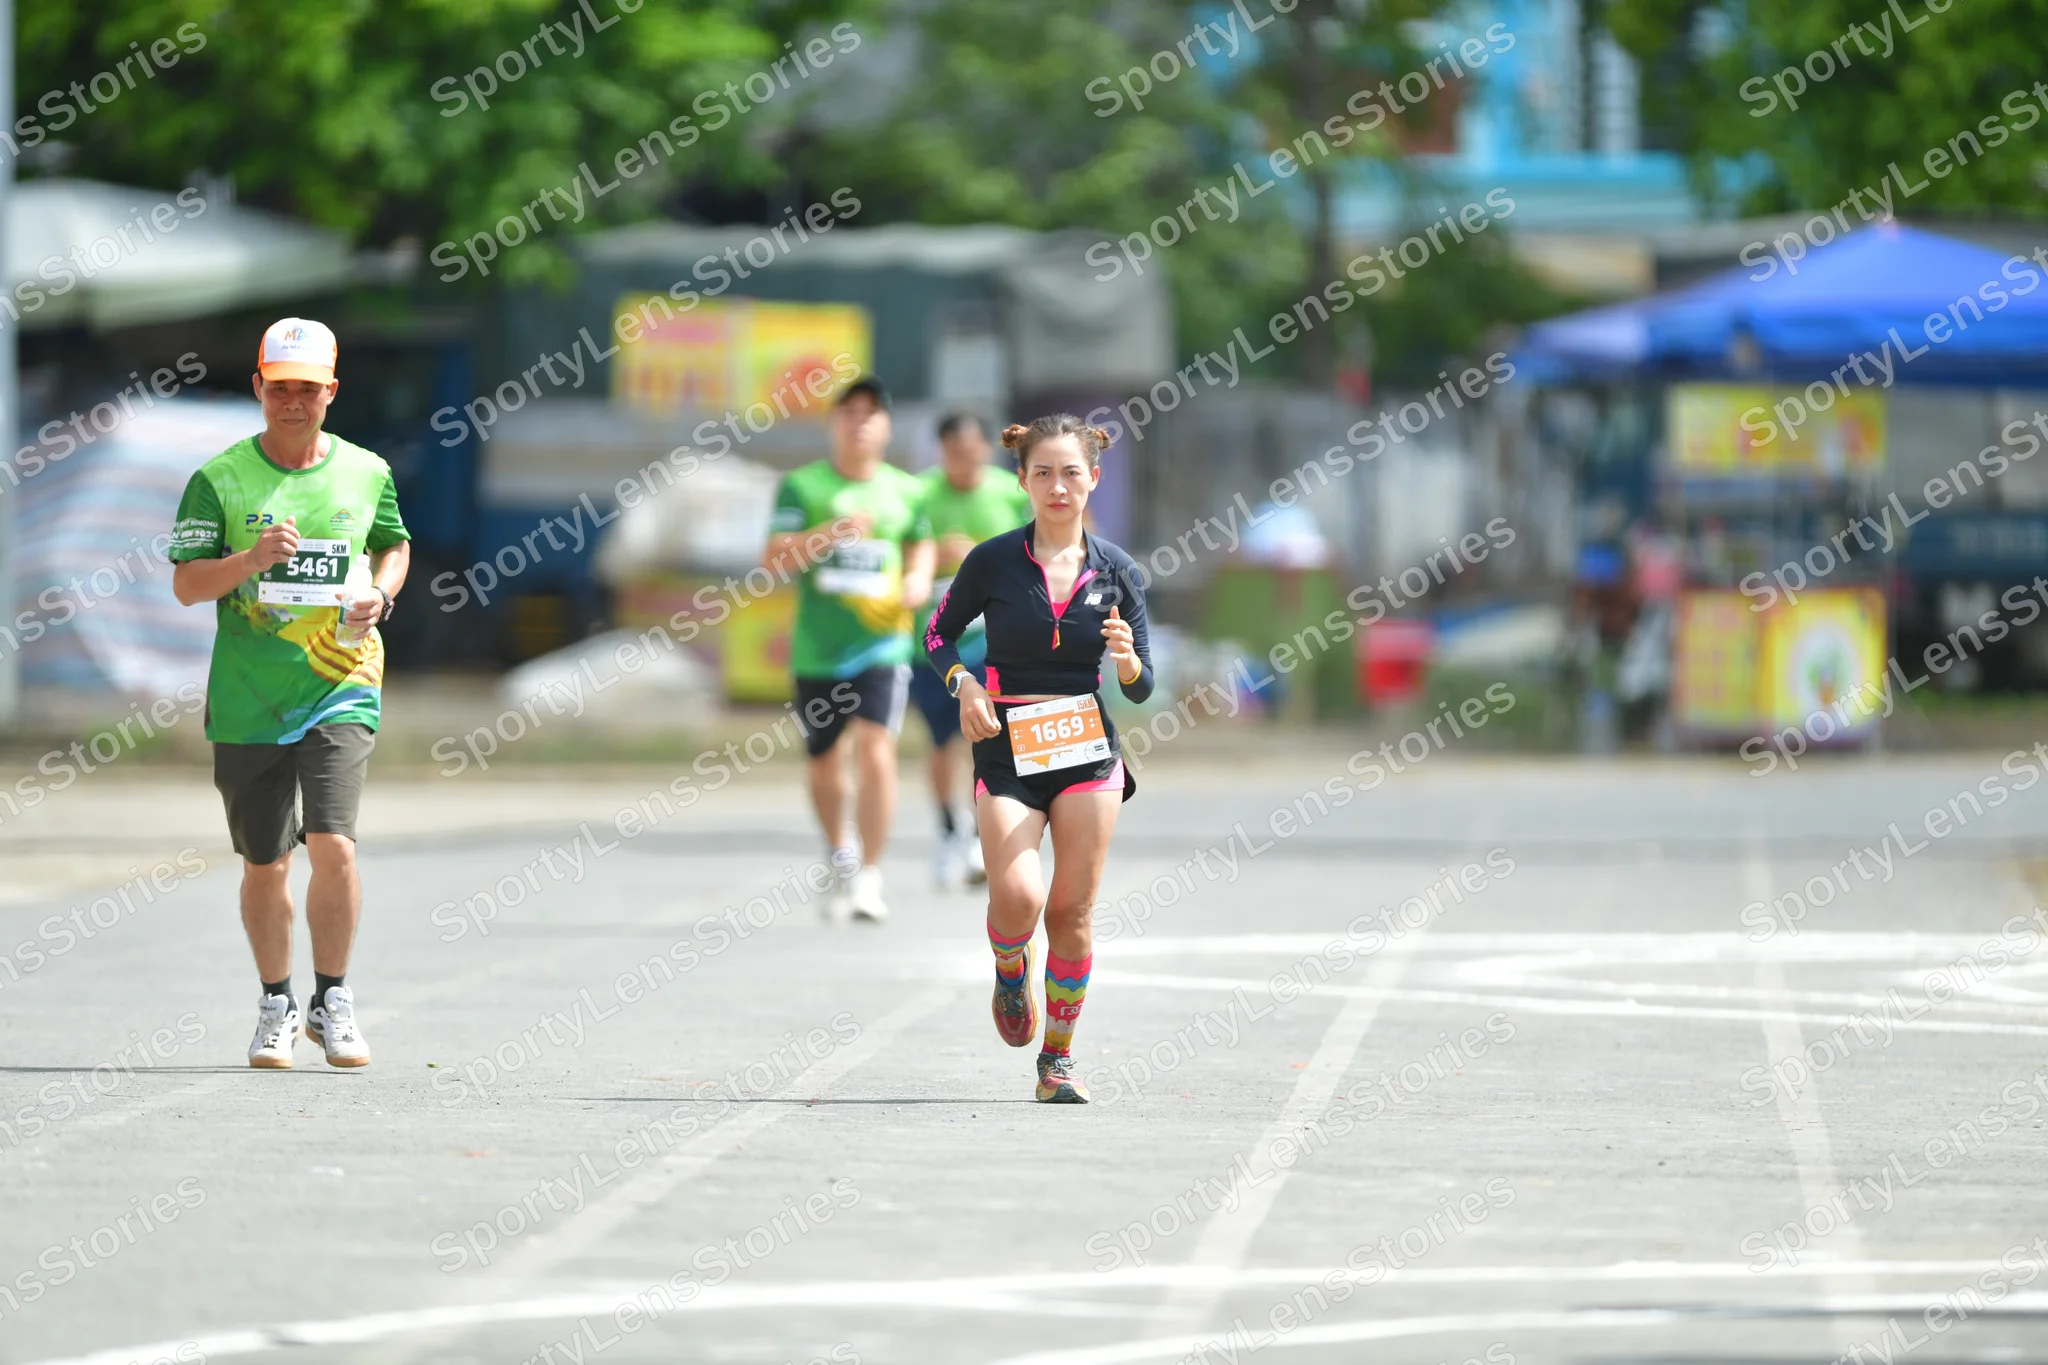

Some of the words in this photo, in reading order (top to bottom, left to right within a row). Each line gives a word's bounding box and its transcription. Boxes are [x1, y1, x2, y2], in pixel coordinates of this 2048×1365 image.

[331, 544, 347, 554] 5KM
[287, 557, 338, 578] 5461
[1076, 697, 1096, 711] 15KM
[1030, 715, 1085, 744] 1669
